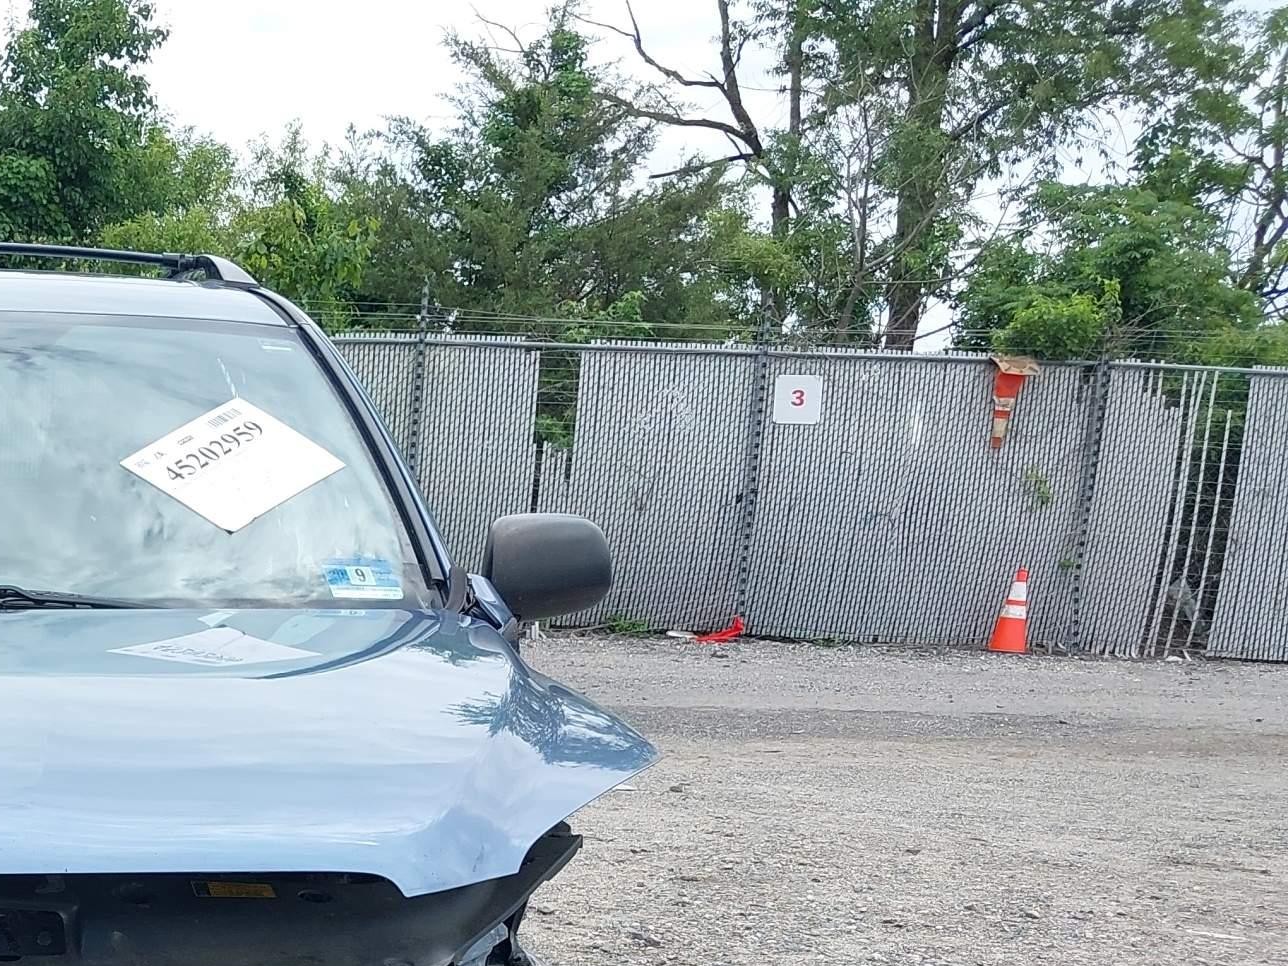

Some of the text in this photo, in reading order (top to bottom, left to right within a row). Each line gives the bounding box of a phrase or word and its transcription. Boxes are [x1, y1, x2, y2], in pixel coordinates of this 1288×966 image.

[791, 390, 805, 406] 3
[166, 420, 263, 482] 45202959
[354, 568, 367, 583] 9
